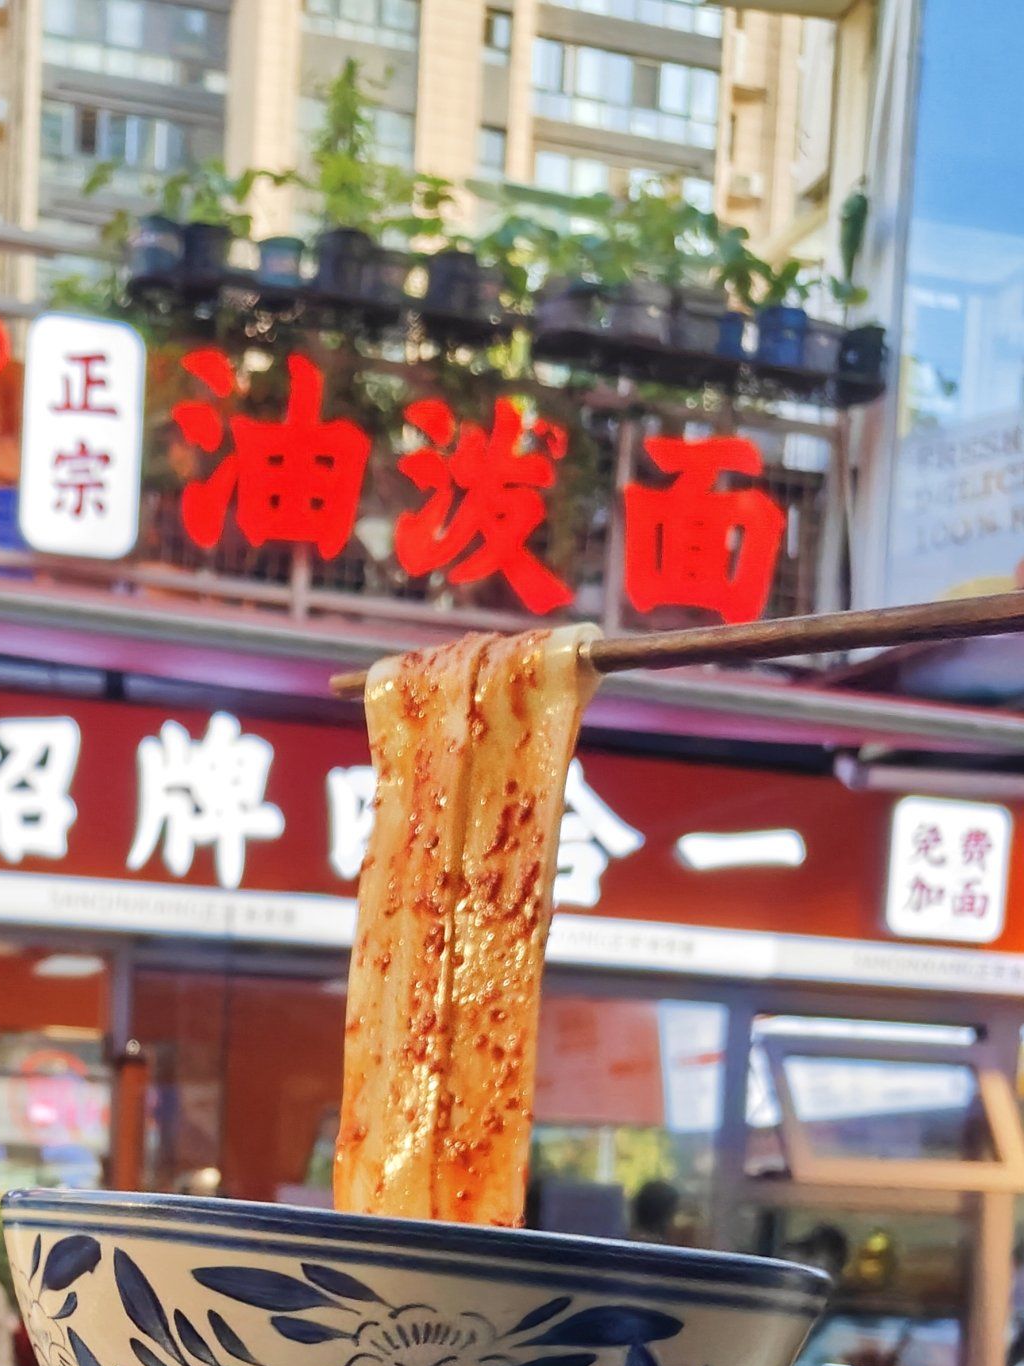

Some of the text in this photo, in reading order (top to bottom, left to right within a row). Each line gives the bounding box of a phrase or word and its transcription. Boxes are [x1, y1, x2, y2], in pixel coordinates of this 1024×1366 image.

[51, 353, 118, 516] 正宗
[173, 346, 788, 624] 油泼面
[903, 874, 989, 919] 加面
[910, 822, 993, 871] 免费
